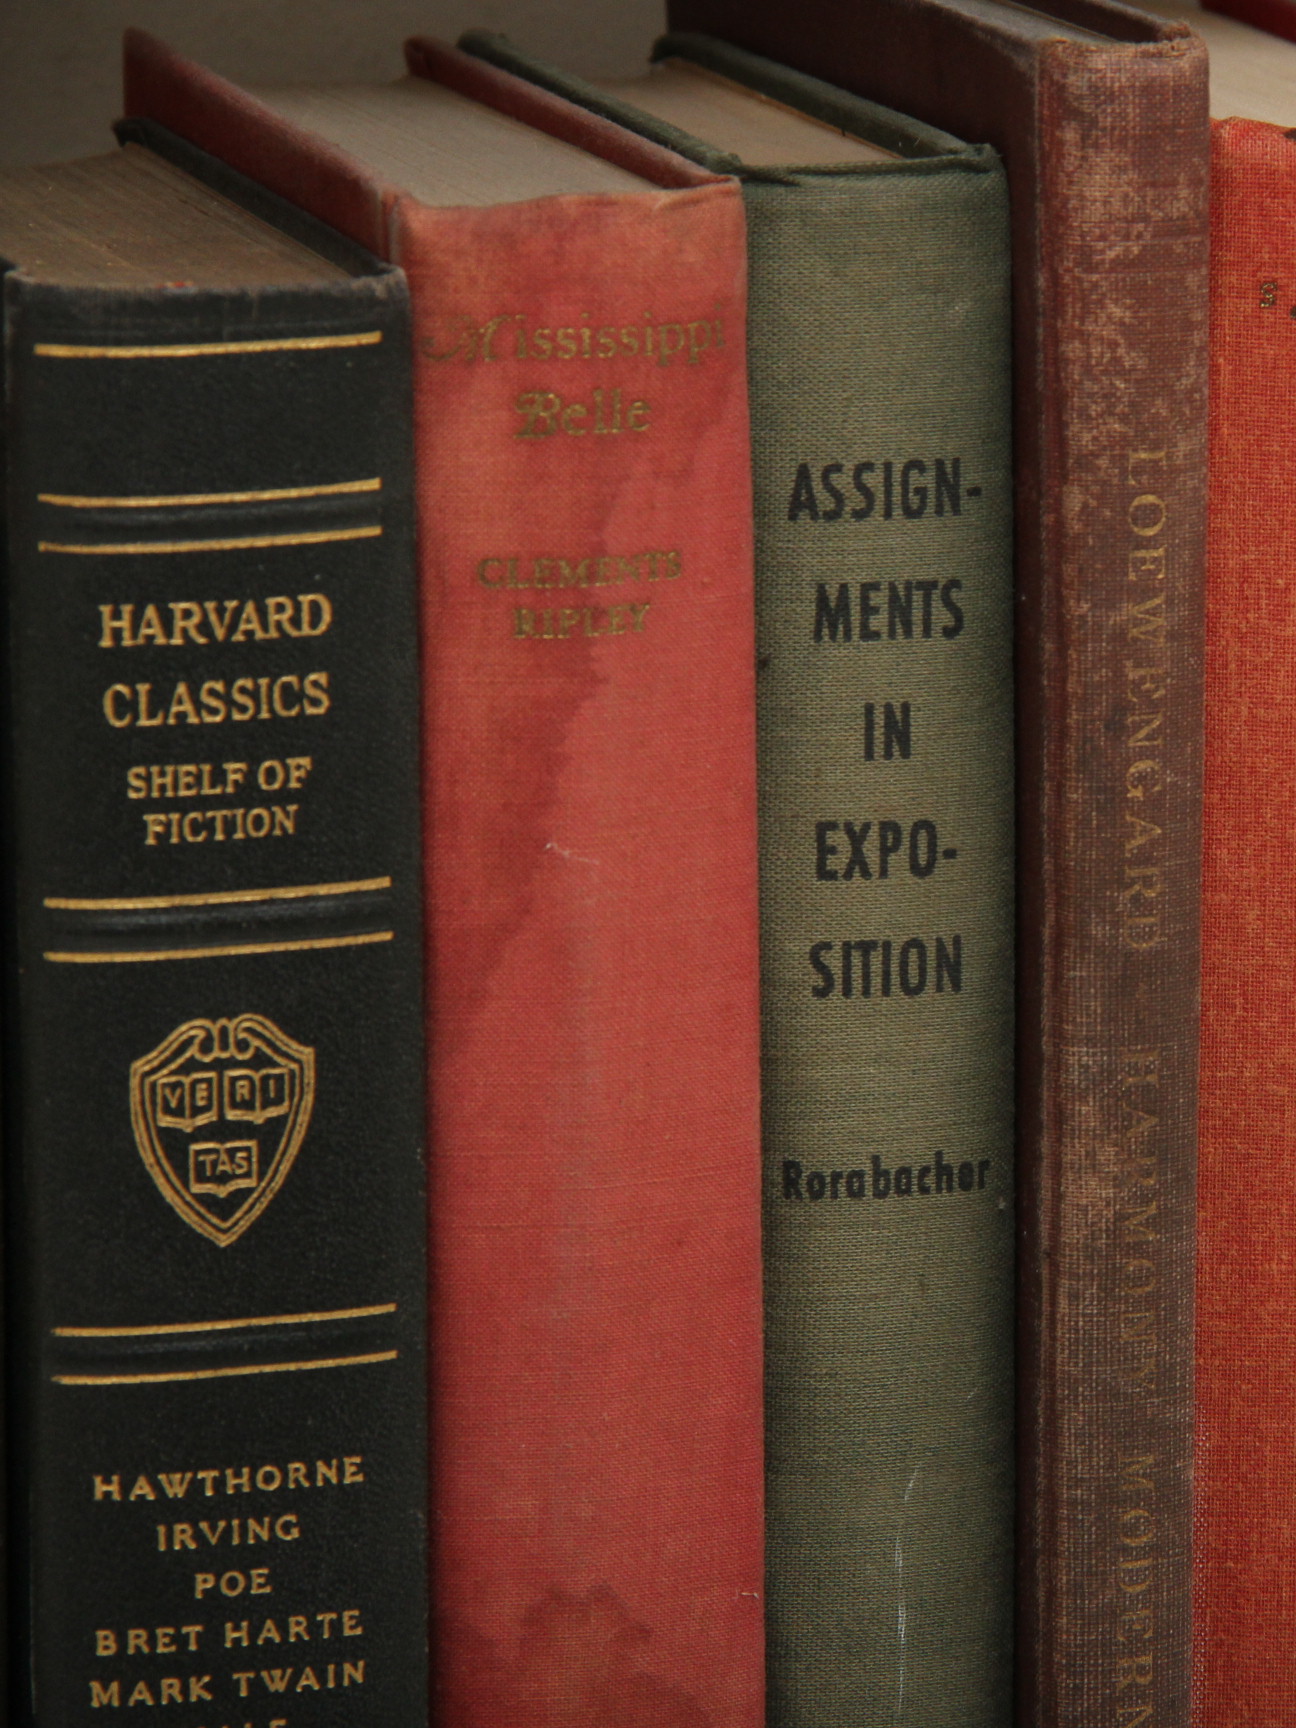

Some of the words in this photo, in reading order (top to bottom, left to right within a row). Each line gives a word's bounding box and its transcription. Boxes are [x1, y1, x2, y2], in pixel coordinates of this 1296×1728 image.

[420, 302, 727, 367] Mississippi
[513, 387, 652, 440] Belle
[787, 458, 983, 523] ASSIGN-
[476, 550, 683, 589] CLEMENTS
[97, 593, 333, 648] HARVARD
[513, 603, 651, 640] RIPLEY
[811, 578, 965, 644] MENTS
[102, 671, 332, 728] CLASSICS
[1124, 450, 1167, 949] LOEWENGARD
[862, 701, 913, 761] IN
[126, 762, 248, 800] SHELF
[257, 756, 312, 791] OF
[143, 805, 299, 846] FICTION
[815, 818, 958, 882] EXPO-
[809, 934, 964, 999] SITION
[198, 1151, 250, 1177] TAS
[782, 1150, 991, 1201] Rorabacher
[92, 1455, 364, 1502] HAWTHORNE
[157, 1514, 302, 1552] IRVING
[194, 1568, 272, 1599] POE
[95, 1624, 204, 1656] BRET
[224, 1609, 363, 1649] HARTE
[89, 1675, 213, 1708] MARK
[232, 1659, 366, 1698] TWAIN
